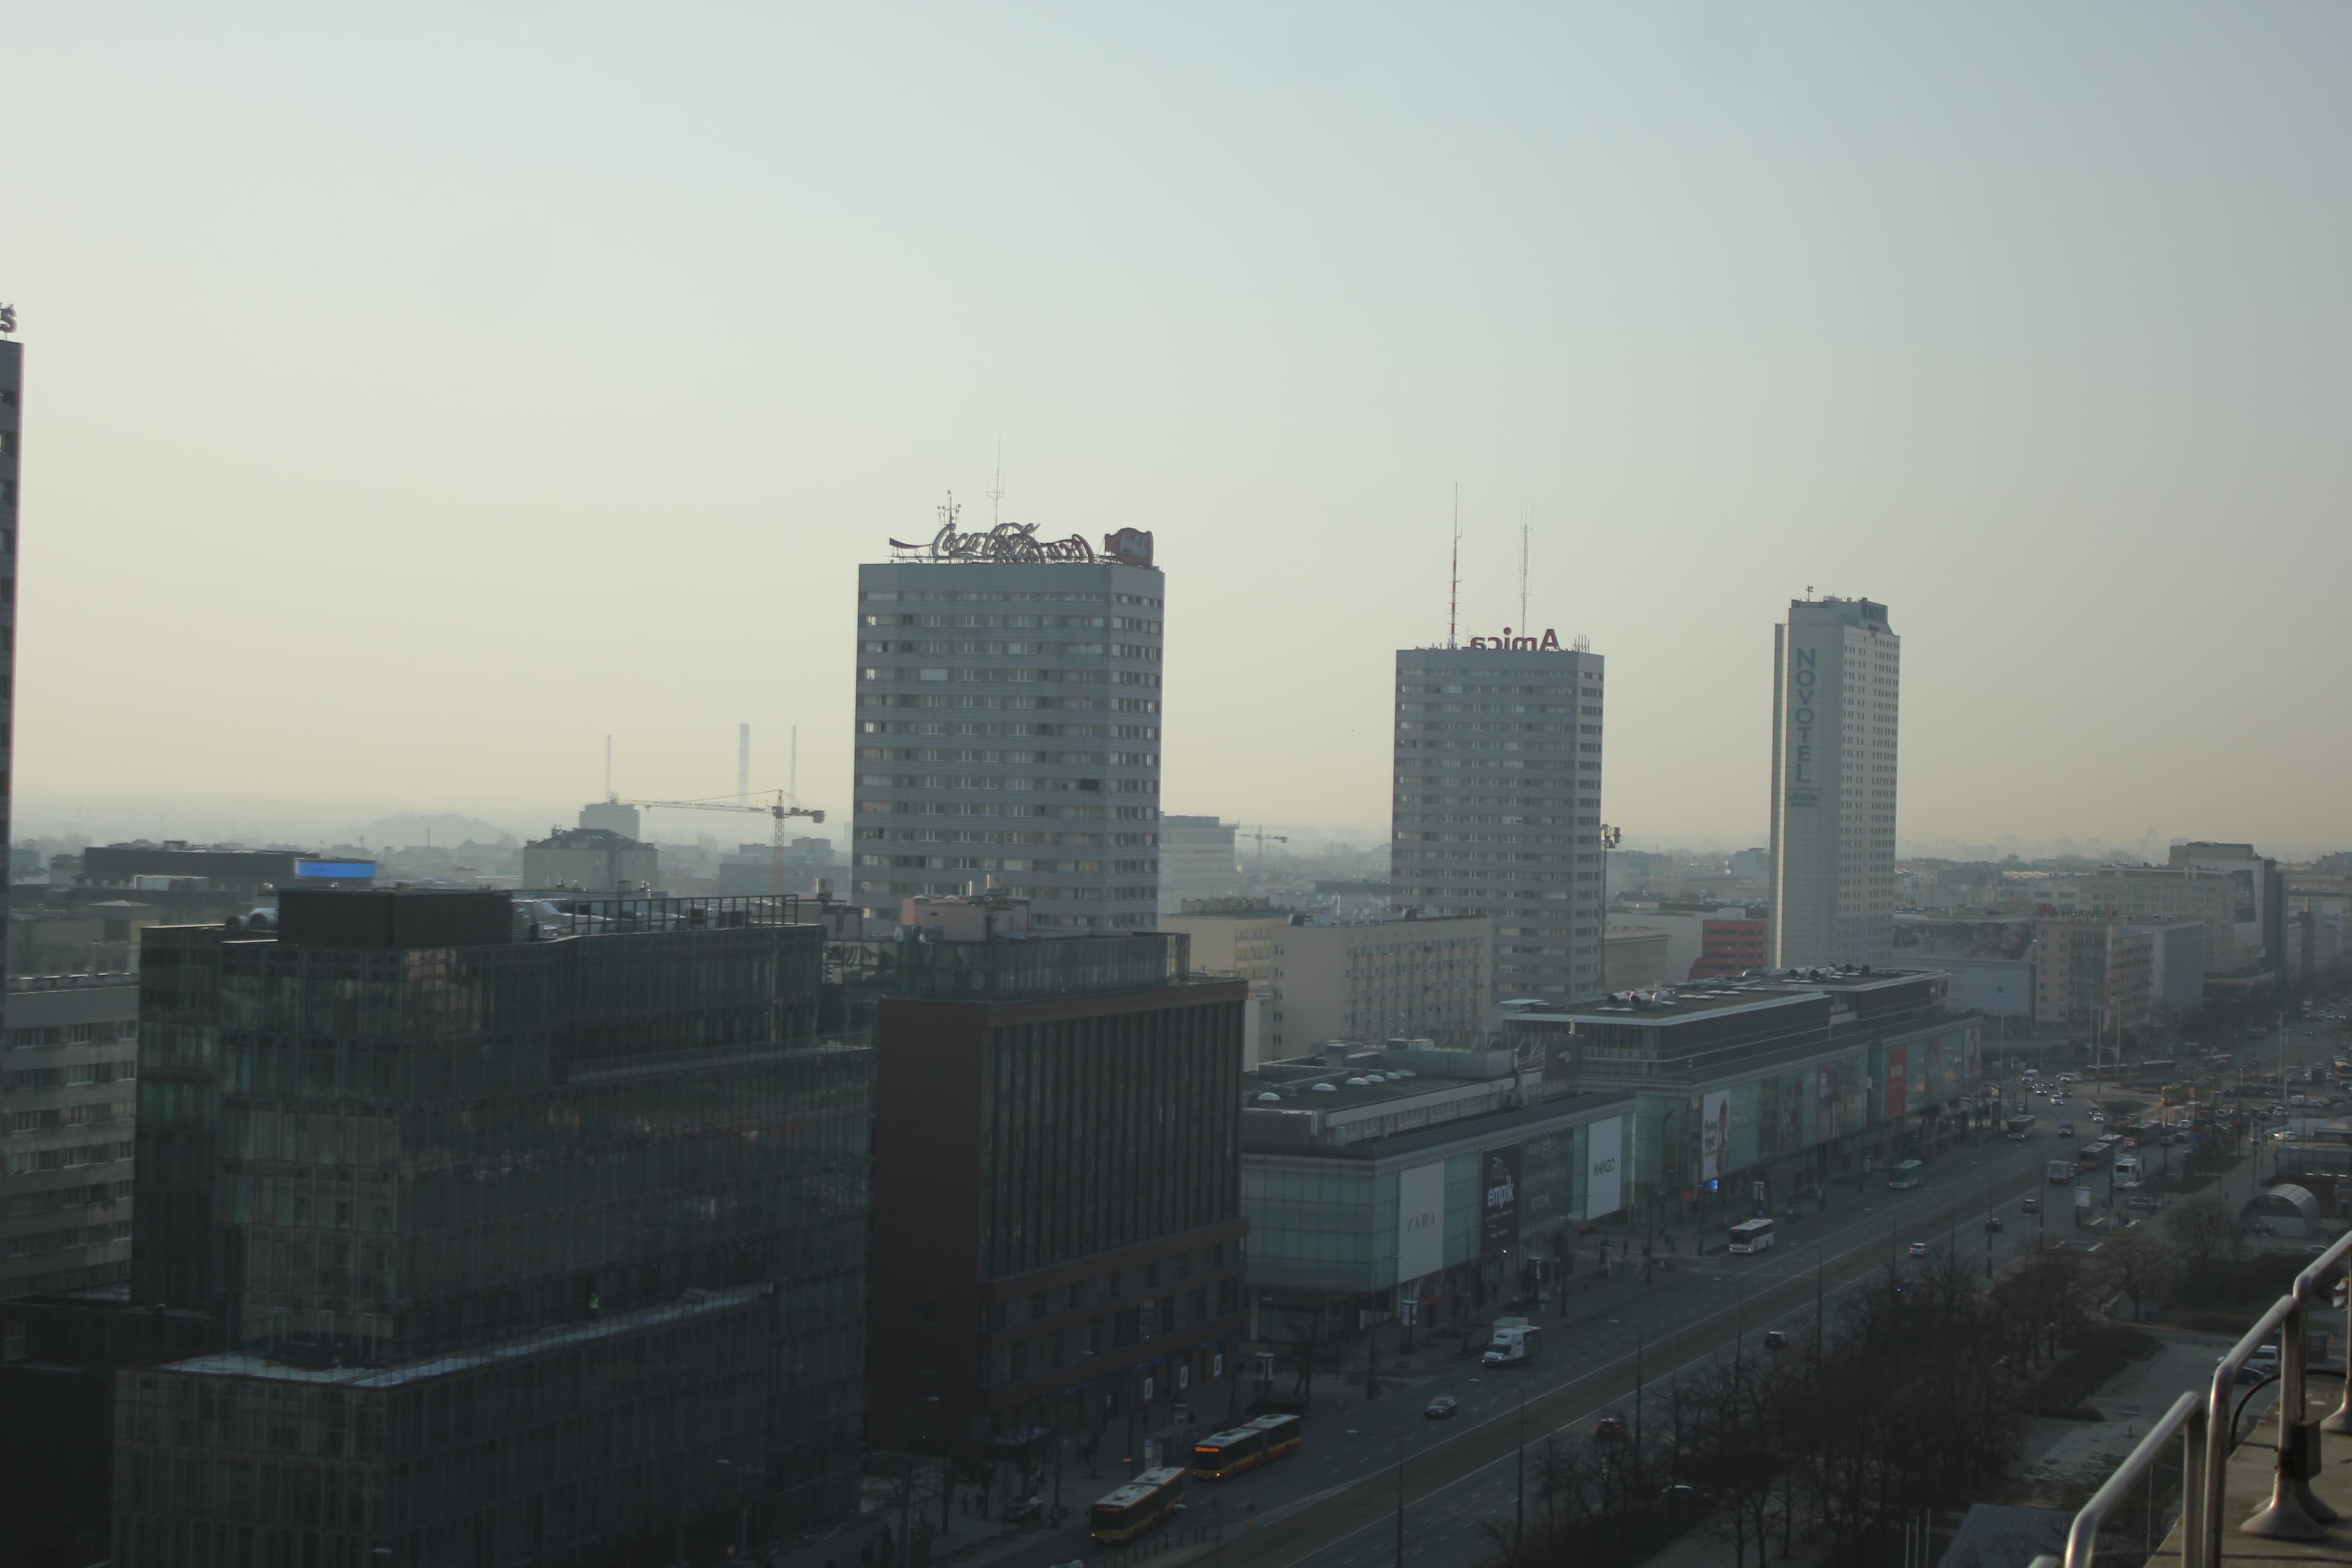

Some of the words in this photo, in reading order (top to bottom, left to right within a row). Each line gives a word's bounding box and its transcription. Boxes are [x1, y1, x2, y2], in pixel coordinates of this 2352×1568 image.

[1795, 648, 1816, 783] NOVOTEL
[1594, 1158, 1615, 1175] MANGO
[1488, 1174, 1514, 1209] empik
[1407, 1212, 1435, 1233] ZARA
